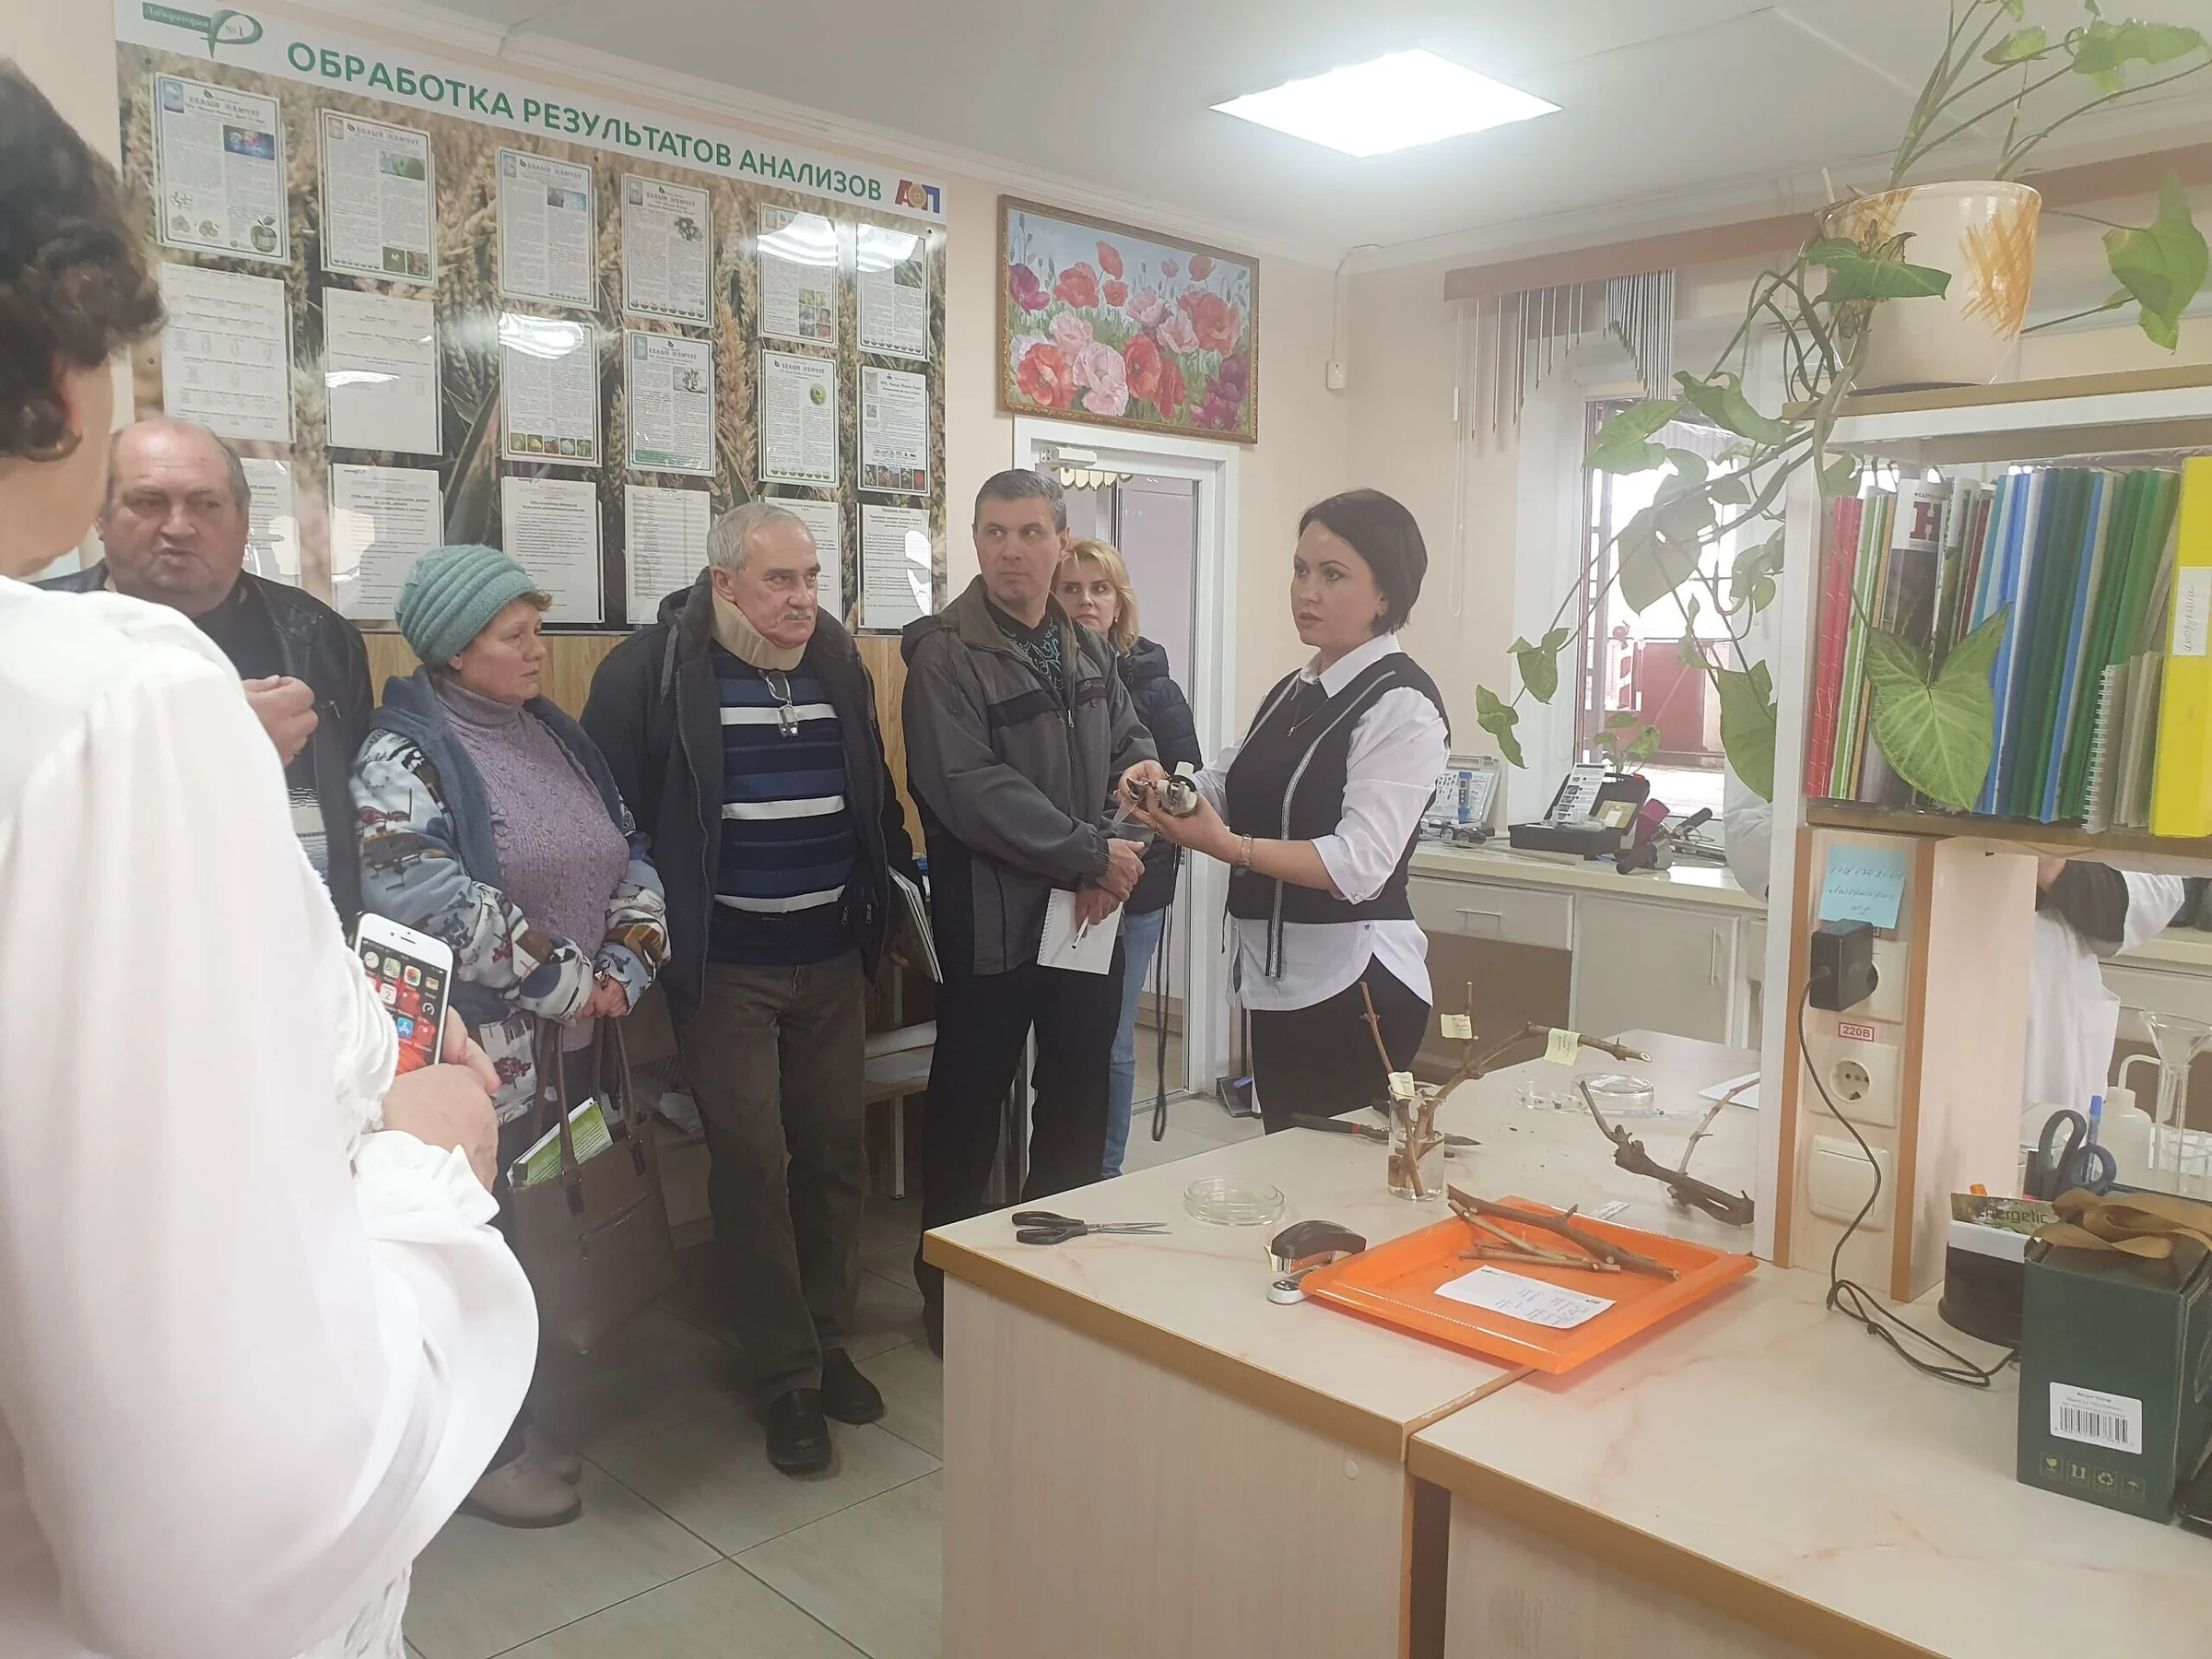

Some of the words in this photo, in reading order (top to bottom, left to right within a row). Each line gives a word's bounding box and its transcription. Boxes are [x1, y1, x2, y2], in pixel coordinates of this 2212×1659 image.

[288, 41, 514, 120] ОБРАБОТКА
[524, 98, 732, 168] РЕЗУЛЬТАТОВ
[739, 149, 883, 202] АНАЛИЗОВ
[1843, 1026, 1870, 1038] 220В
